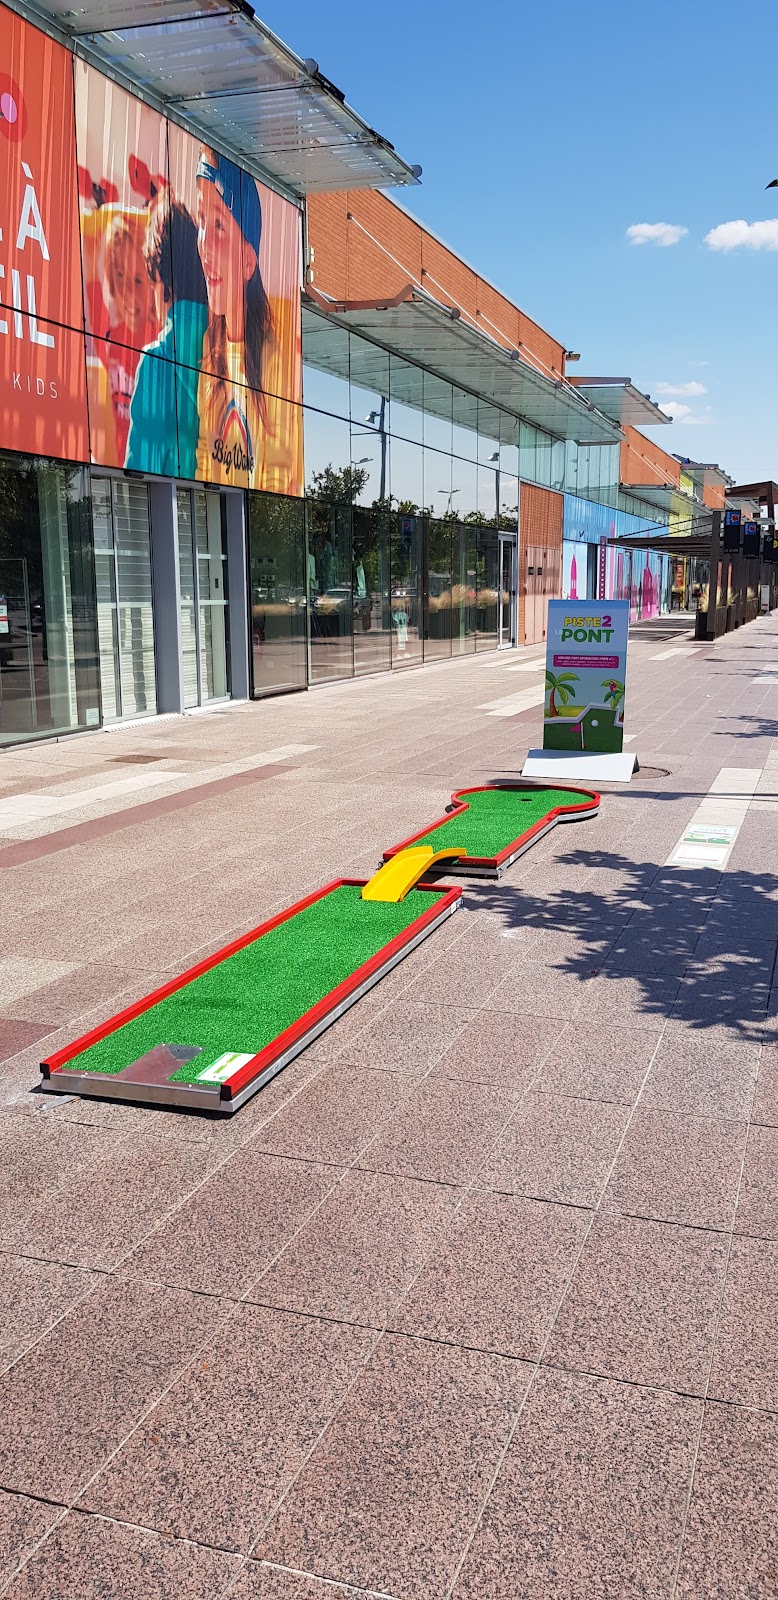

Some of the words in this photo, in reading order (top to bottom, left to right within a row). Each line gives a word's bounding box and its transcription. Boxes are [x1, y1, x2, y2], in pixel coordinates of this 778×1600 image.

[16, 161, 50, 261] À
[13, 371, 59, 399] KIDS
[212, 438, 233, 475] Big
[564, 616, 601, 627] PISTE
[602, 615, 612, 627] 2
[561, 628, 614, 643] PONT
